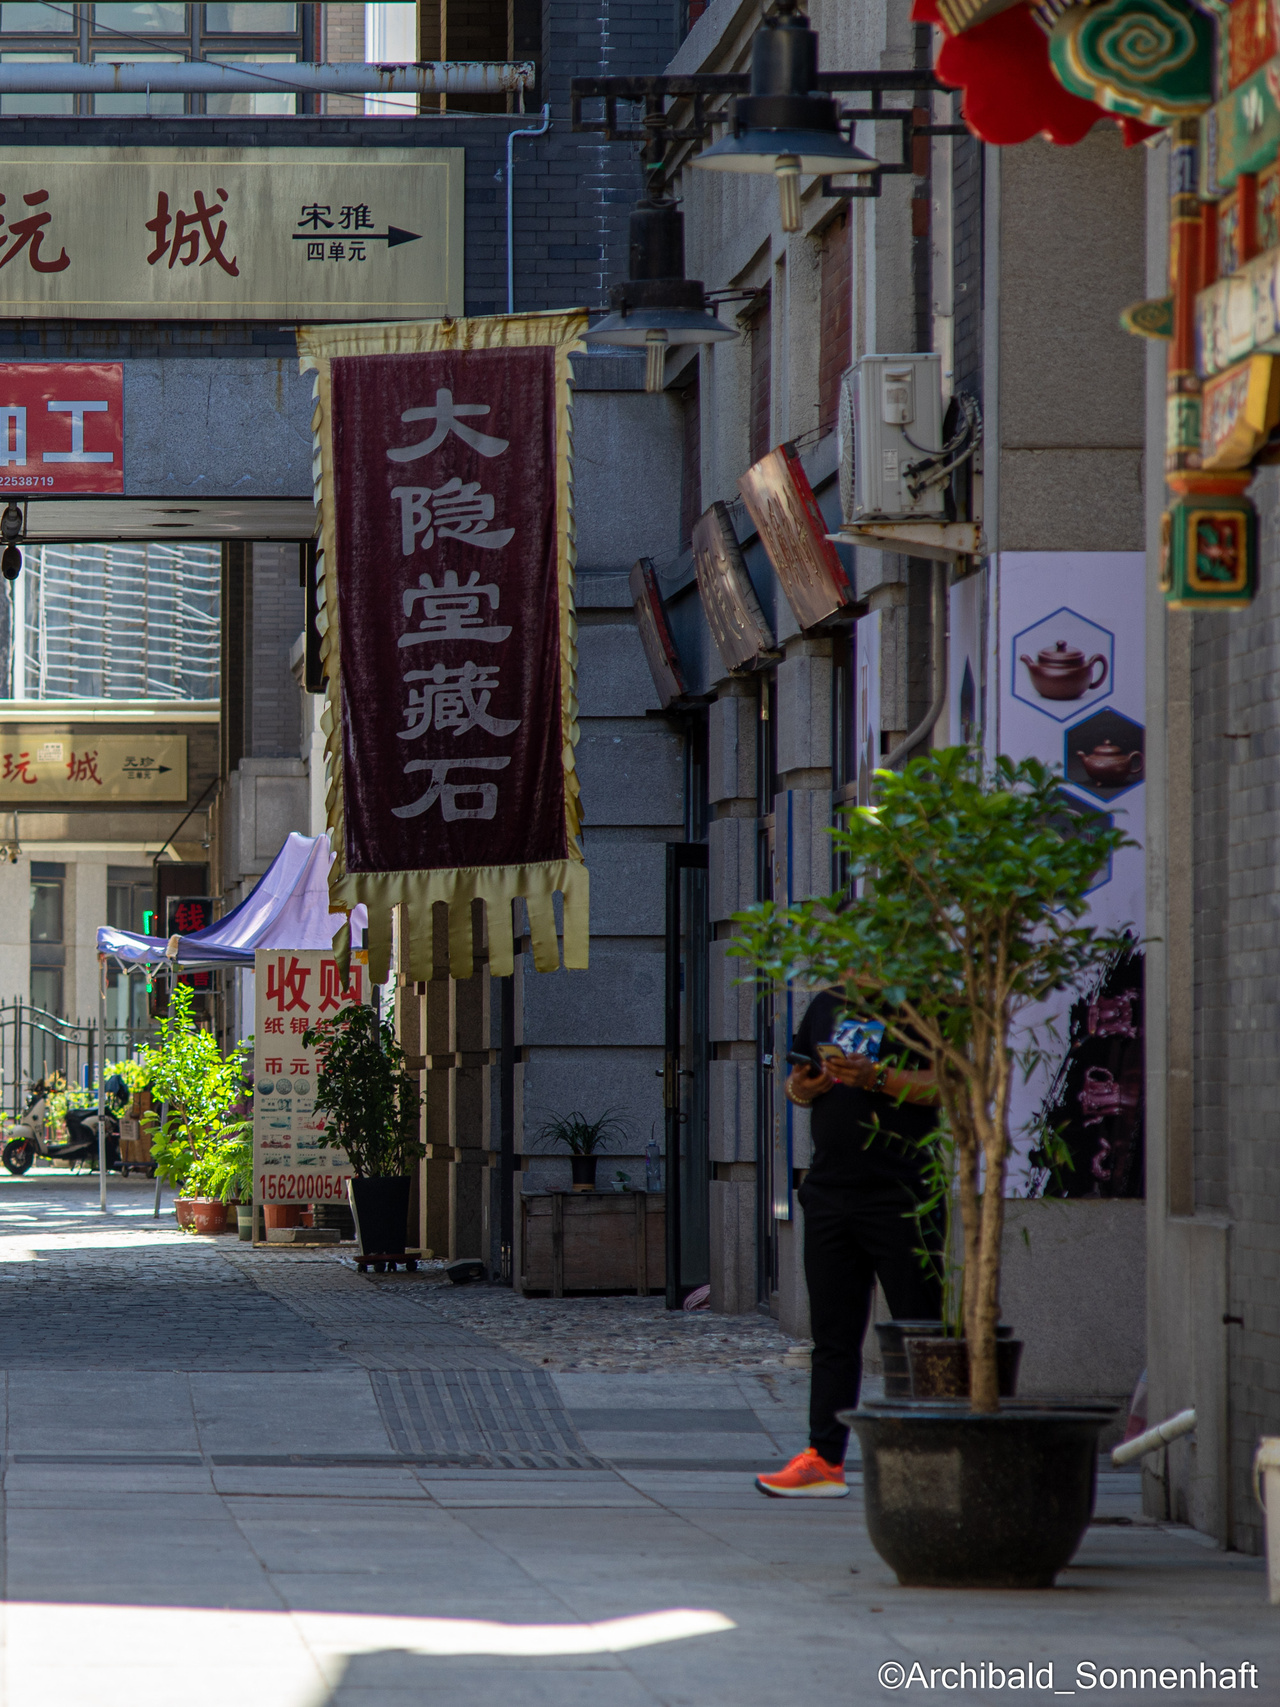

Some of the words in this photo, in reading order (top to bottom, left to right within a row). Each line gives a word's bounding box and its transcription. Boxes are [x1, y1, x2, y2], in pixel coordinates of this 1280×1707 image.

[297, 202, 375, 230] 宋雅
[307, 241, 367, 262] 四单元
[386, 388, 522, 823] 大隐堂藏石
[266, 956, 362, 1013] 收购
[260, 1174, 359, 1200] 1562000547
